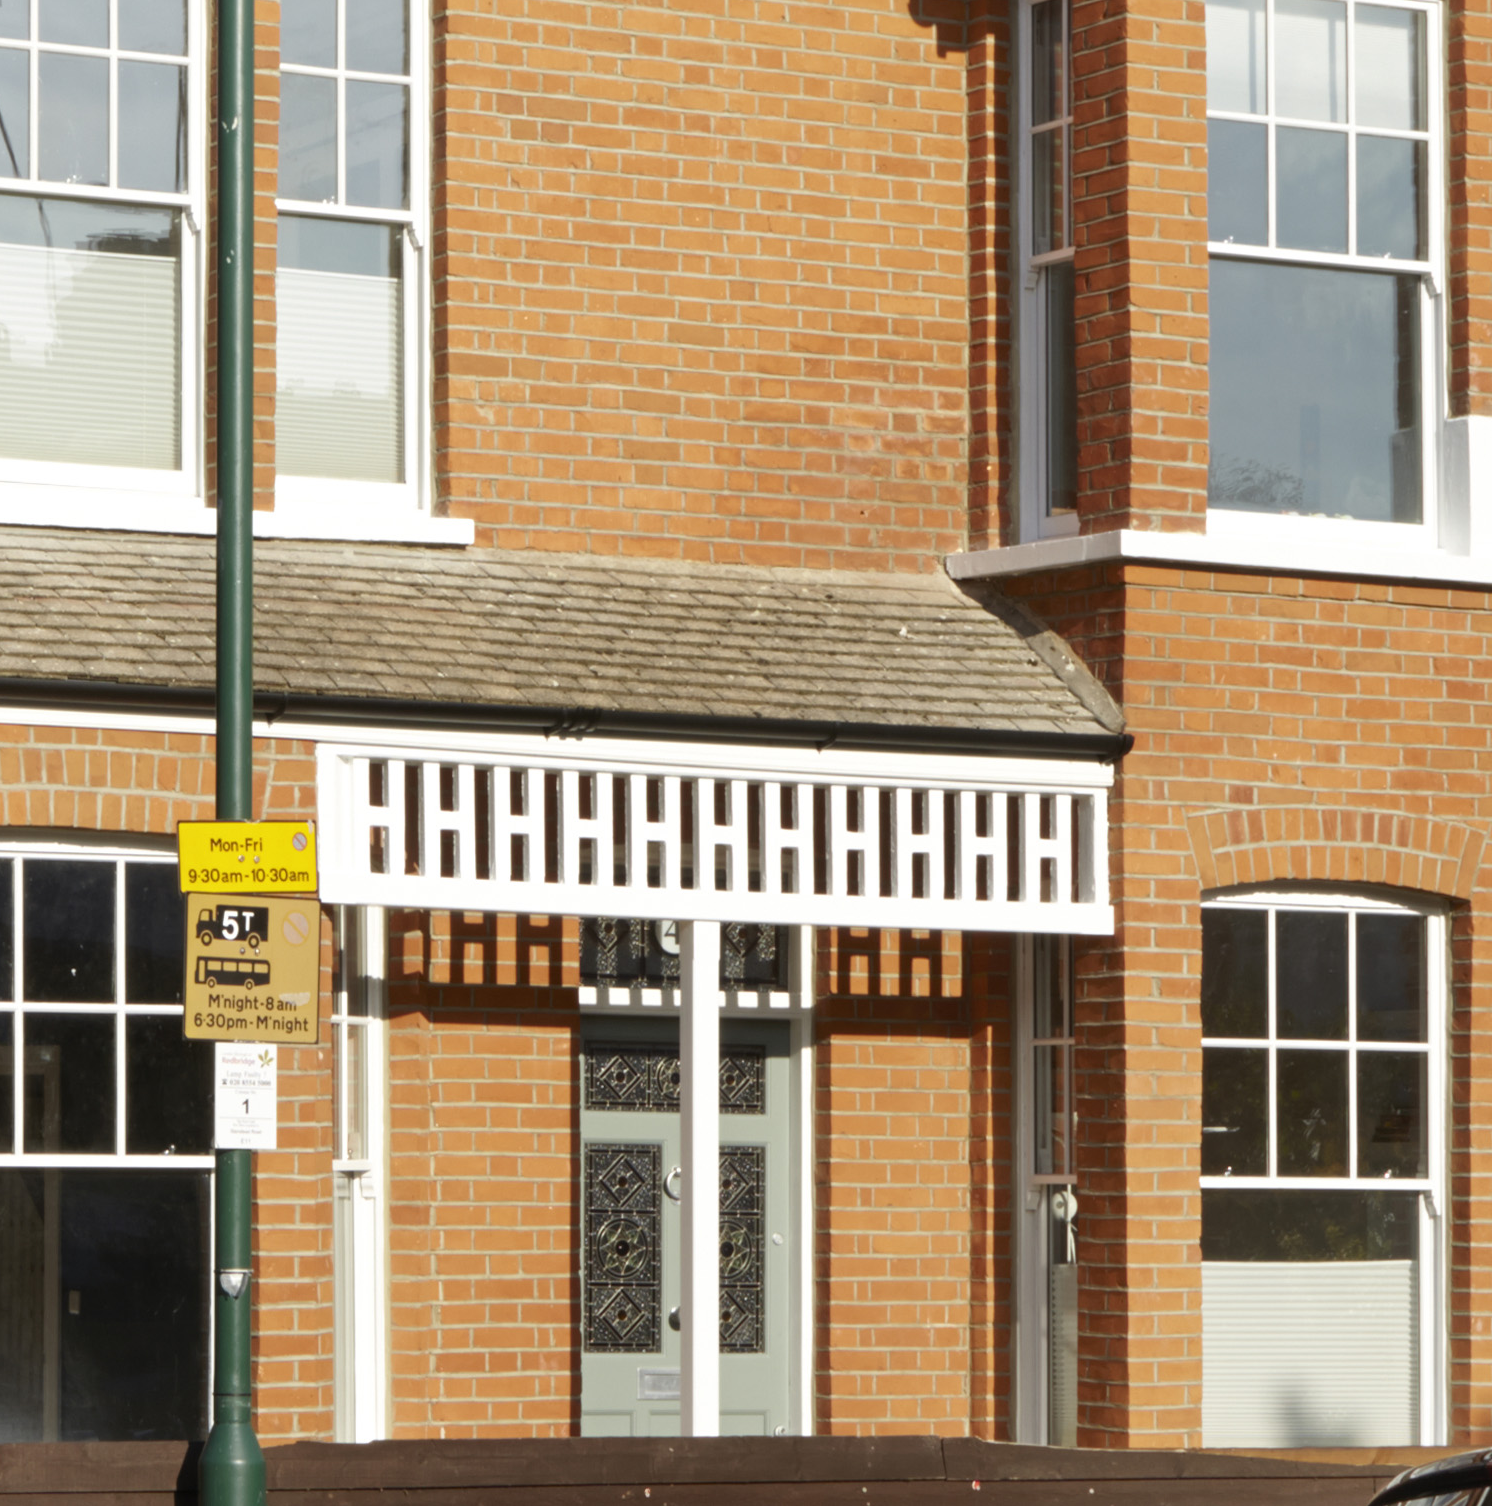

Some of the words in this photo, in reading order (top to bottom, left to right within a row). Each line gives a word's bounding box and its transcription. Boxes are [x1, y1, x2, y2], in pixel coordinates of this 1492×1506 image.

[210, 838, 263, 852] Mon-Fri
[222, 1056, 256, 1066] Redbridge
[242, 1099, 249, 1114] 1
